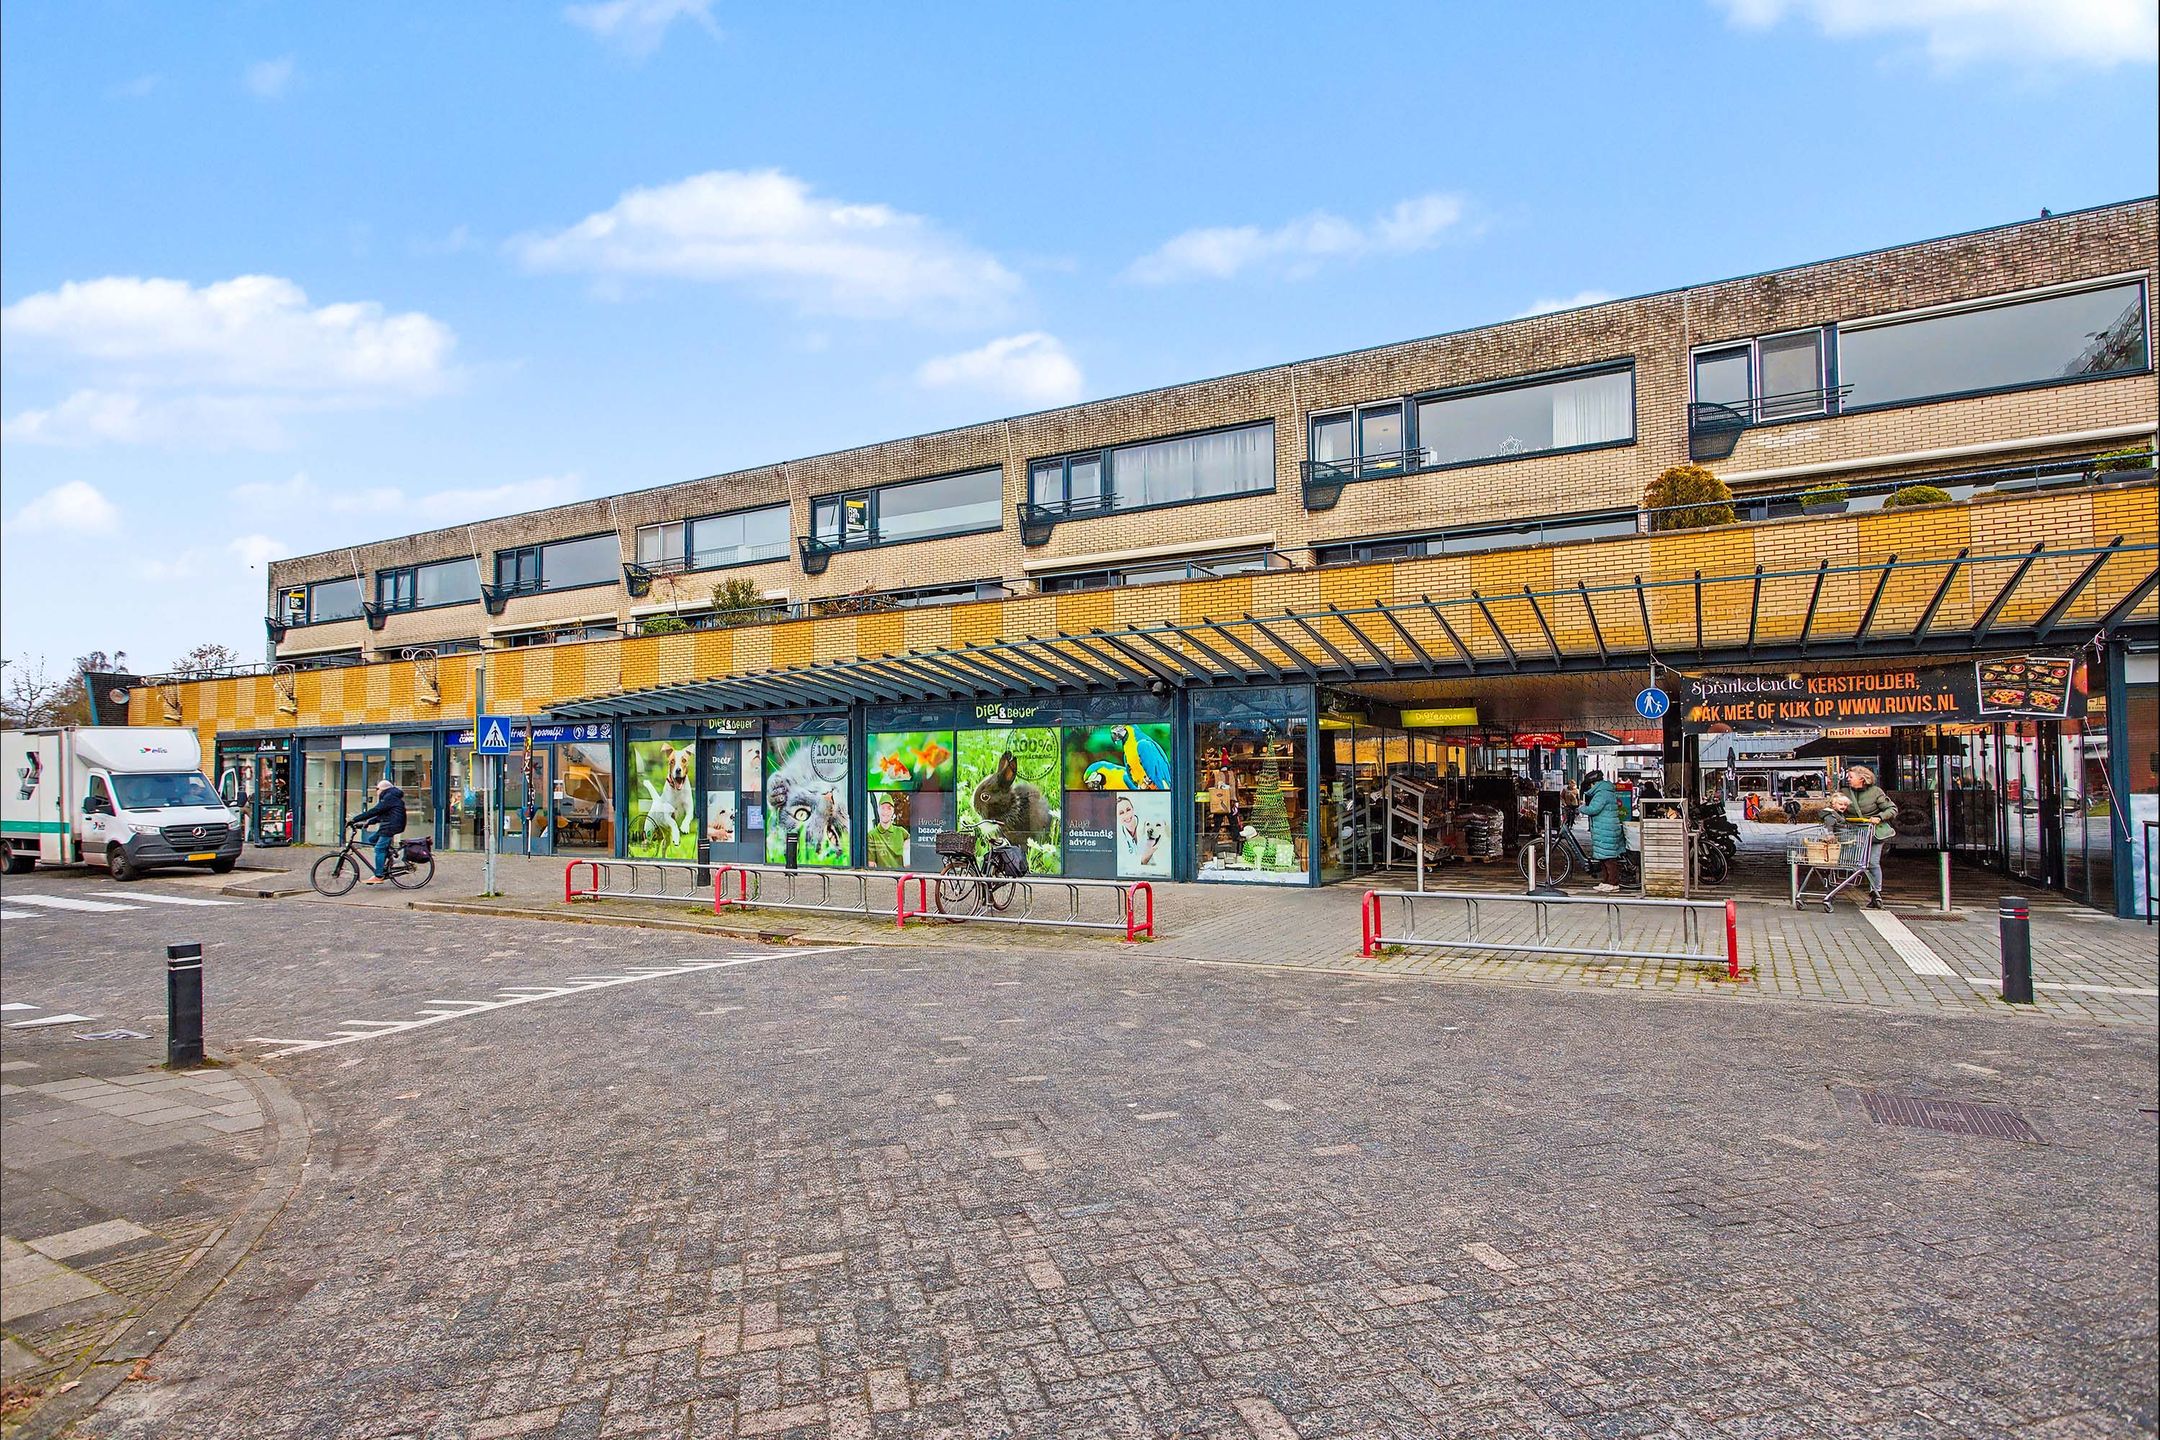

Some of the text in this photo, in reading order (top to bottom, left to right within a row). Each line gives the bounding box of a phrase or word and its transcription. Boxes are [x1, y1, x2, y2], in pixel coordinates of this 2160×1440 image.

[1691, 672, 1921, 699] Sprankelende KERSTFOLDER,
[975, 703, 1002, 719] Dier
[1724, 703, 1754, 720] MEE
[1758, 702, 1775, 719] OF
[1779, 701, 1811, 718] KIJK
[1814, 700, 1834, 717] OP
[1838, 693, 1959, 716] WWW.RUVIS.NL
[816, 743, 848, 757] 100%
[1012, 738, 1053, 753] 100%
[1069, 829, 1114, 839] deskundig
[1069, 838, 1097, 847] advies
